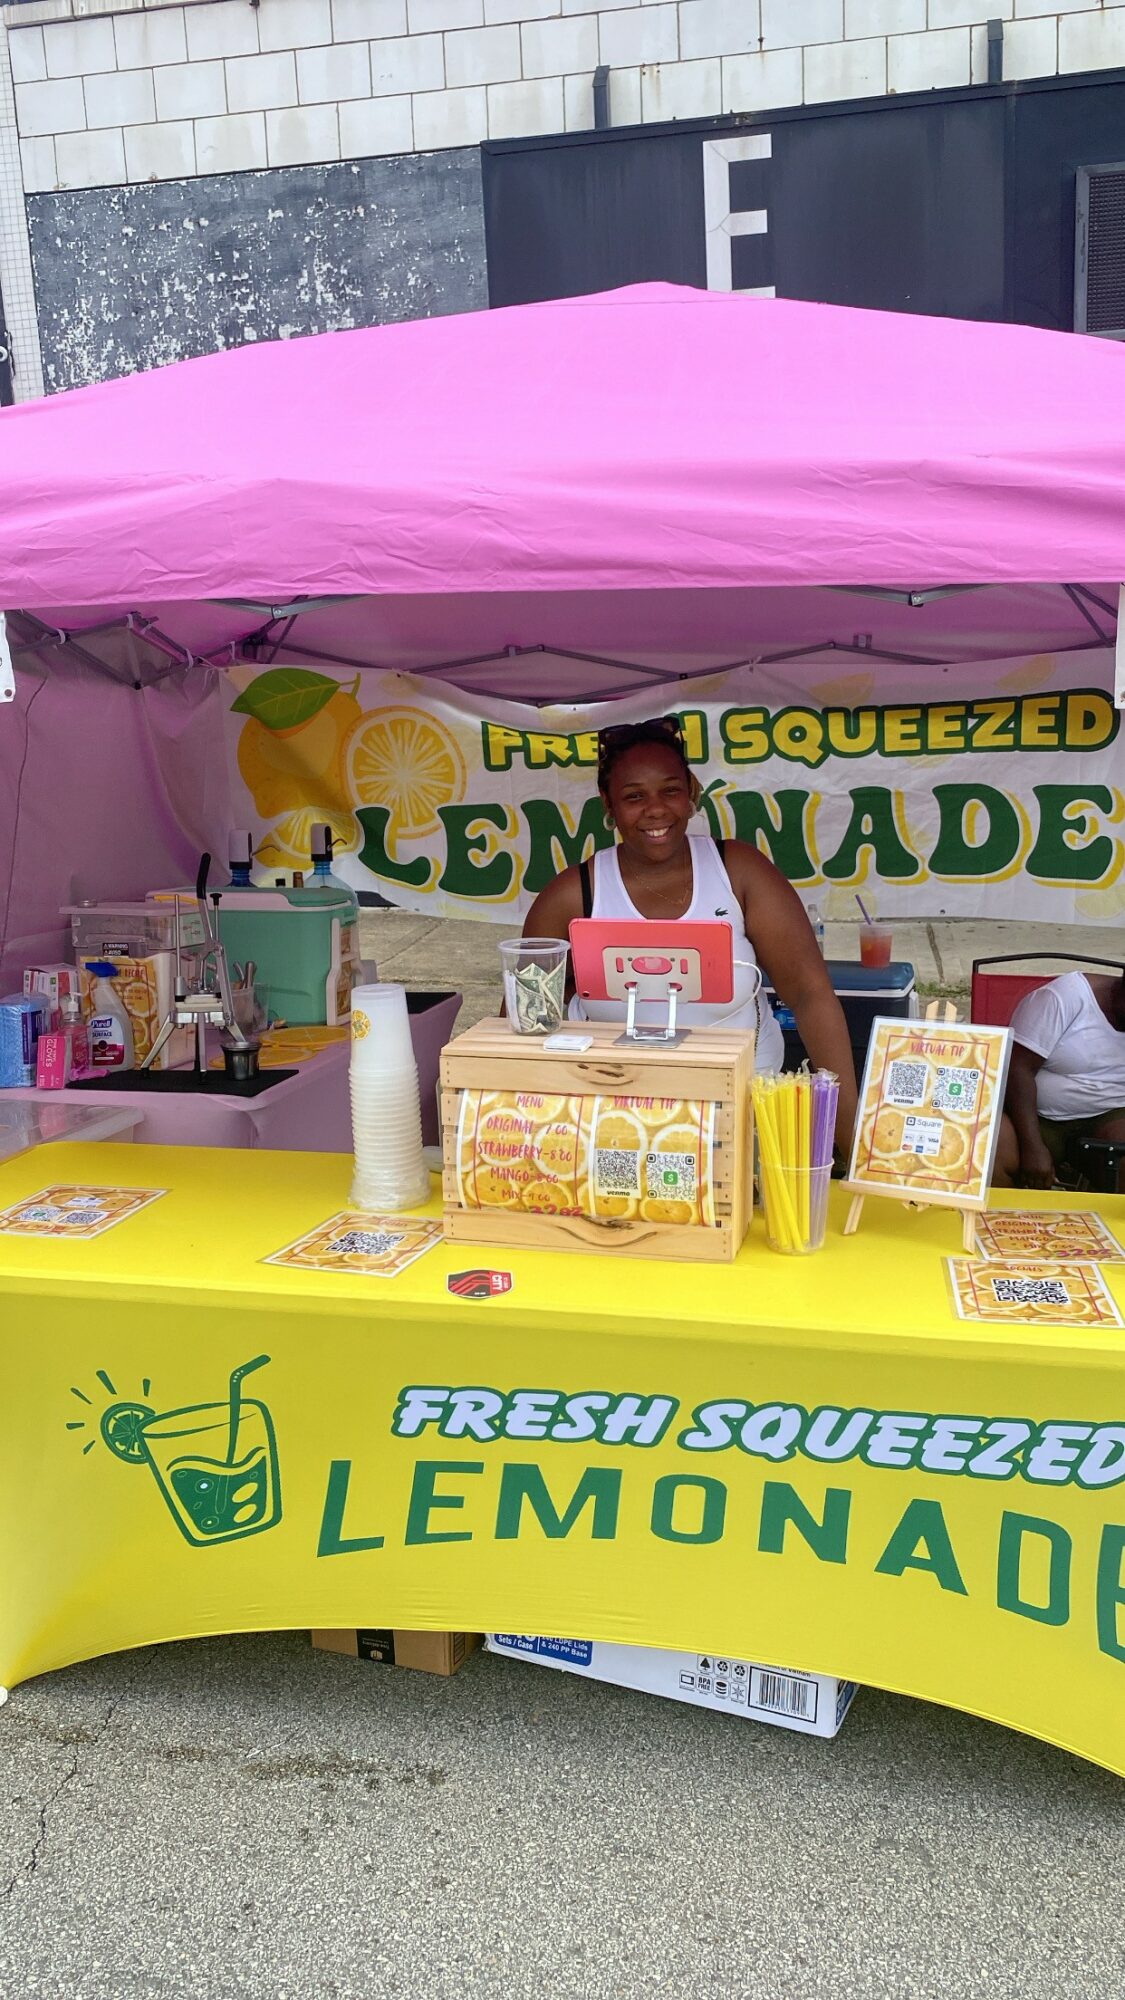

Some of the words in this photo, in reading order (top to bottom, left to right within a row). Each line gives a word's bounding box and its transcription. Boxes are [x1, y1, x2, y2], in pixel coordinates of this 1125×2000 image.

[703, 133, 775, 299] E
[481, 709, 709, 772] FREH
[719, 687, 1121, 769] SQUEEZED
[355, 778, 1125, 904] LEMNADE
[910, 1042, 946, 1056] VIRTUAL
[950, 1046, 965, 1057] TIP
[516, 1095, 545, 1109] MENU
[613, 1095, 655, 1110] VIRTUAL
[660, 1097, 677, 1110] TIP
[916, 1118, 942, 1128] Square
[606, 1189, 631, 1197] venmo
[390, 1385, 680, 1448] FRESH
[677, 1398, 1125, 1491] SQUEEZED
[498, 1635, 512, 1645] Sets
[517, 1640, 533, 1650] Case
[573, 1642, 588, 1651] Lids
[547, 1643, 559, 1651] 240
[560, 1645, 570, 1653] PP
[571, 1649, 588, 1658] Base
[697, 1684, 711, 1692] FREE
[698, 1677, 711, 1685] BPA
